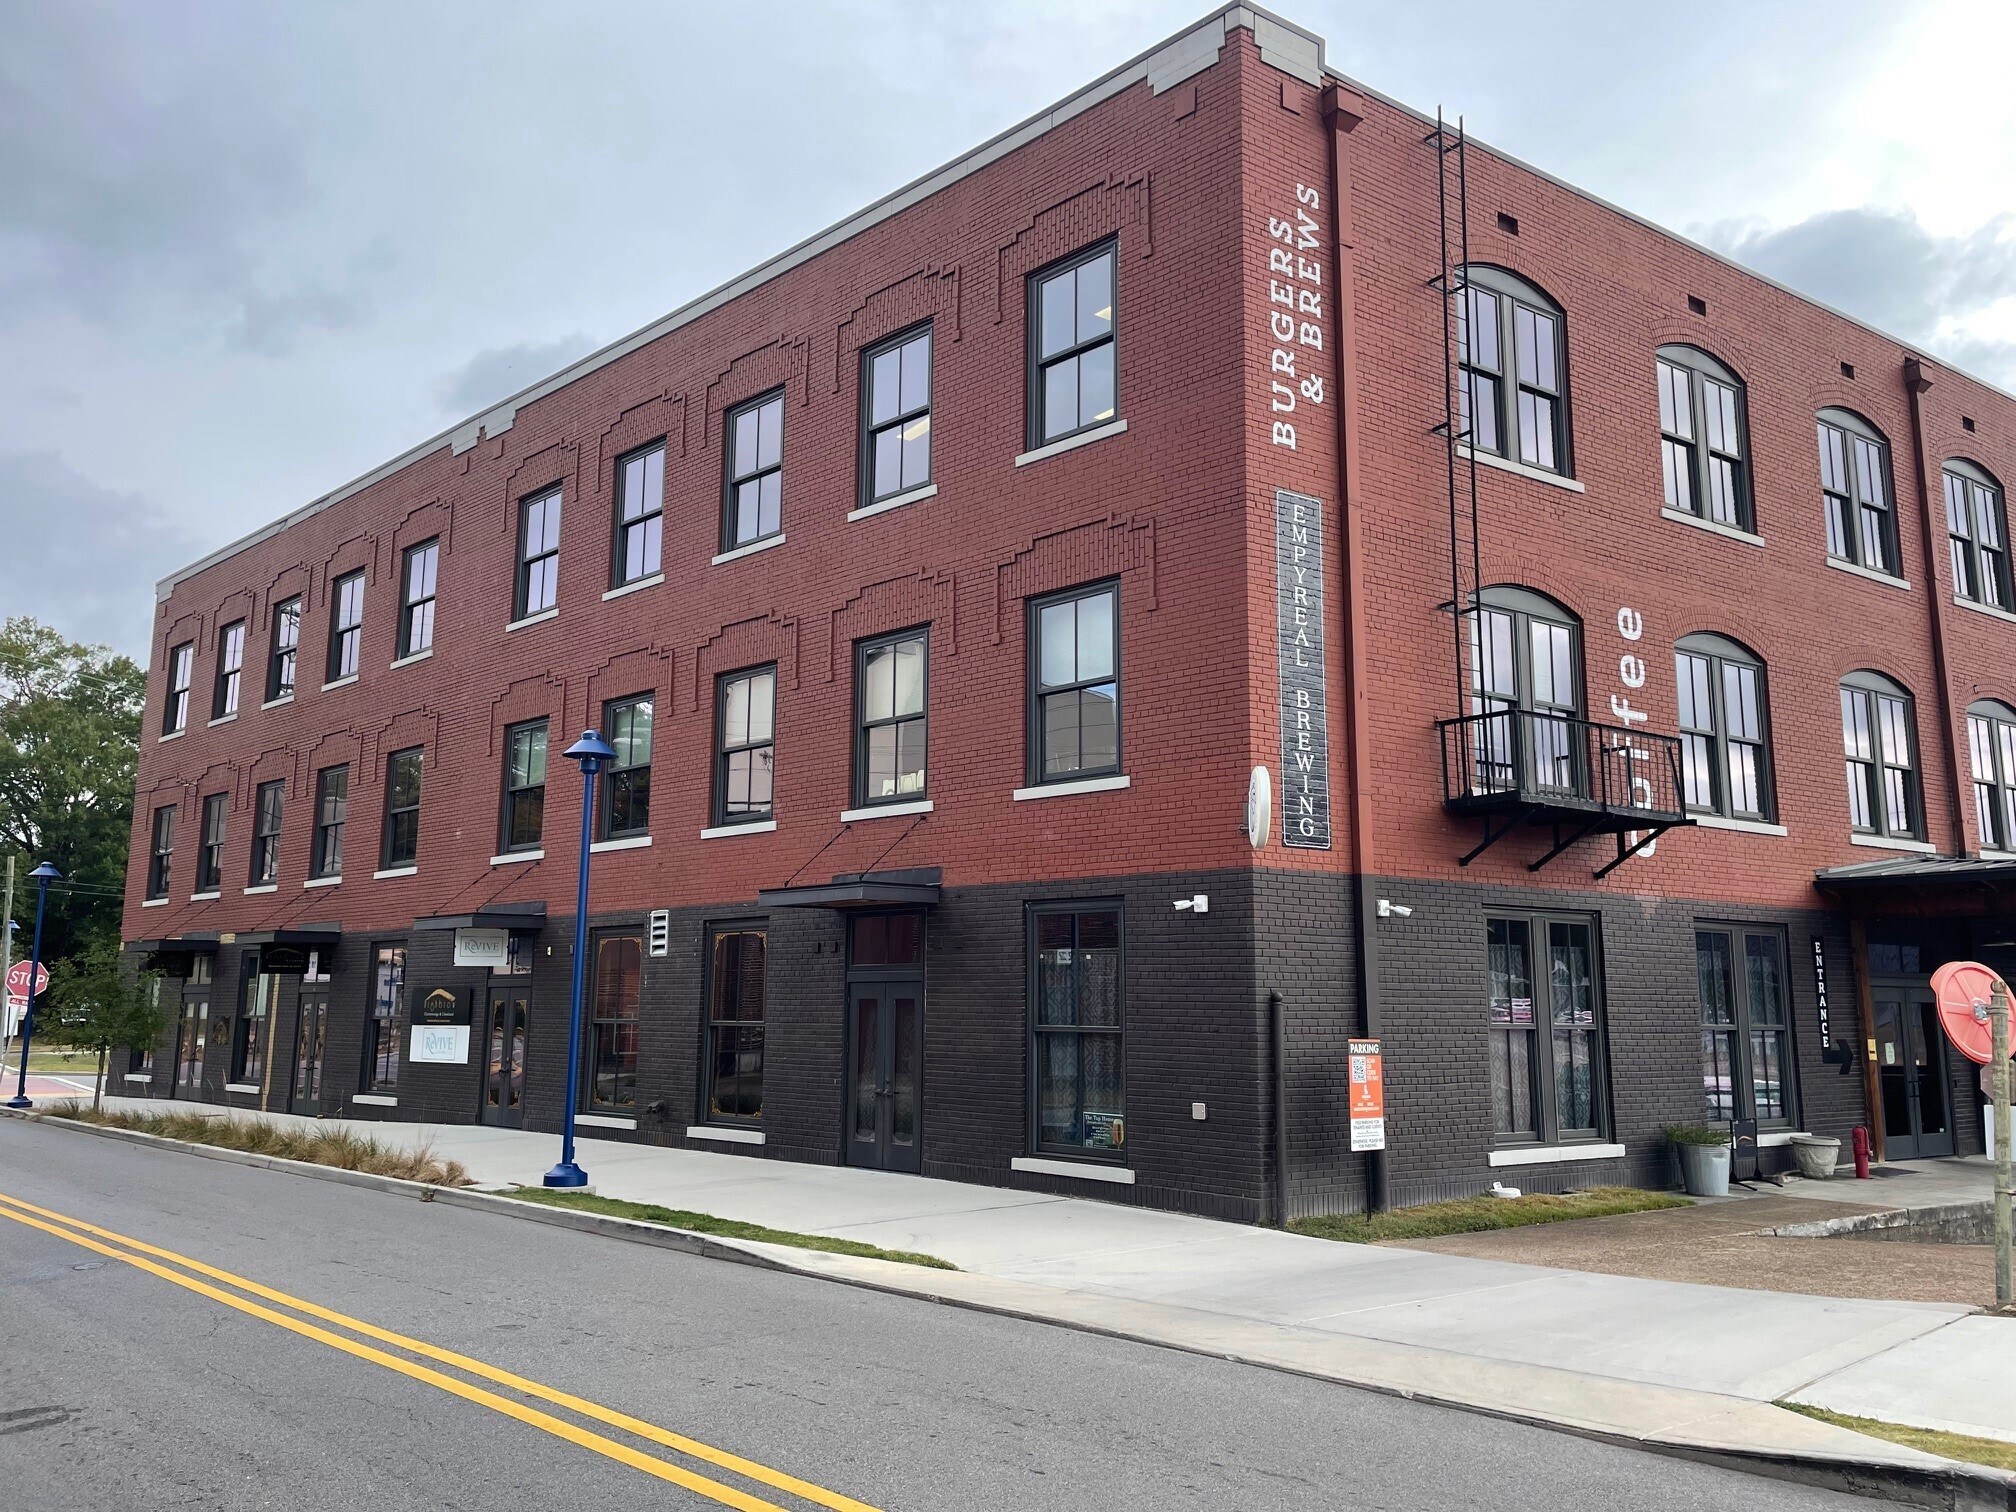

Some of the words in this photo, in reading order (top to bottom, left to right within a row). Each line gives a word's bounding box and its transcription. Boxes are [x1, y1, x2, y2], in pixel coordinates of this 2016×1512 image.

[1269, 216, 1296, 450] BURGERS
[1296, 182, 1323, 351] BREWS
[1300, 373, 1324, 404] &
[1292, 504, 1310, 668] EMPYREAL
[1294, 689, 1315, 837] BREWING
[1350, 1043, 1380, 1054] PARKING
[1814, 941, 1829, 1048] ENTRANCE
